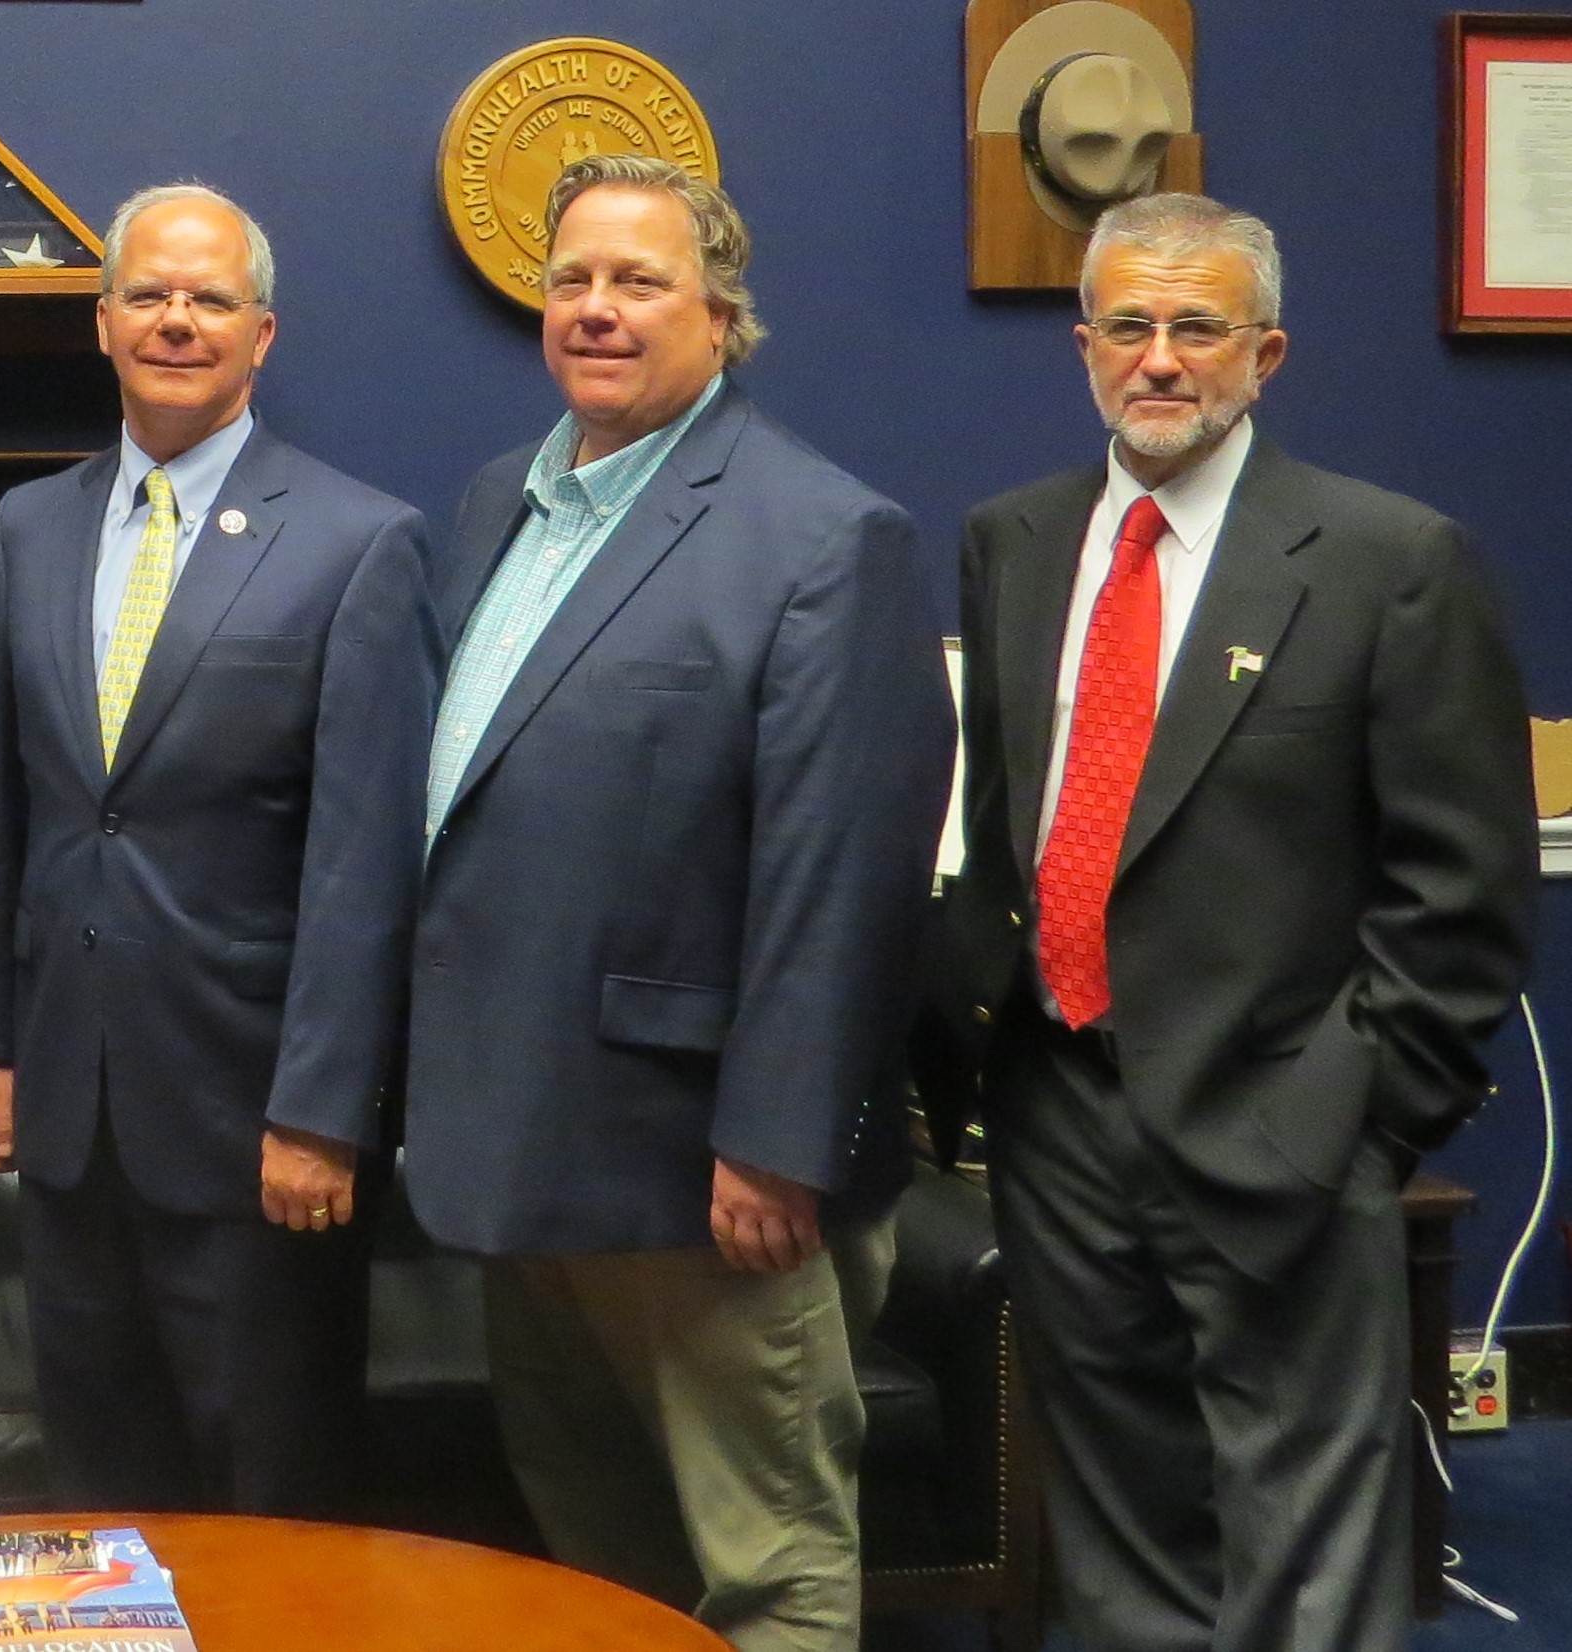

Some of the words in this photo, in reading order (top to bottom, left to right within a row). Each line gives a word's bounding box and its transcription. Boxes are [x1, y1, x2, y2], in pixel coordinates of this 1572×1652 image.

[458, 54, 588, 241] COMMONWEALTH
[605, 61, 639, 91] OF
[514, 107, 558, 150] UNITED
[567, 100, 592, 117] WE
[600, 107, 645, 146] STAND
